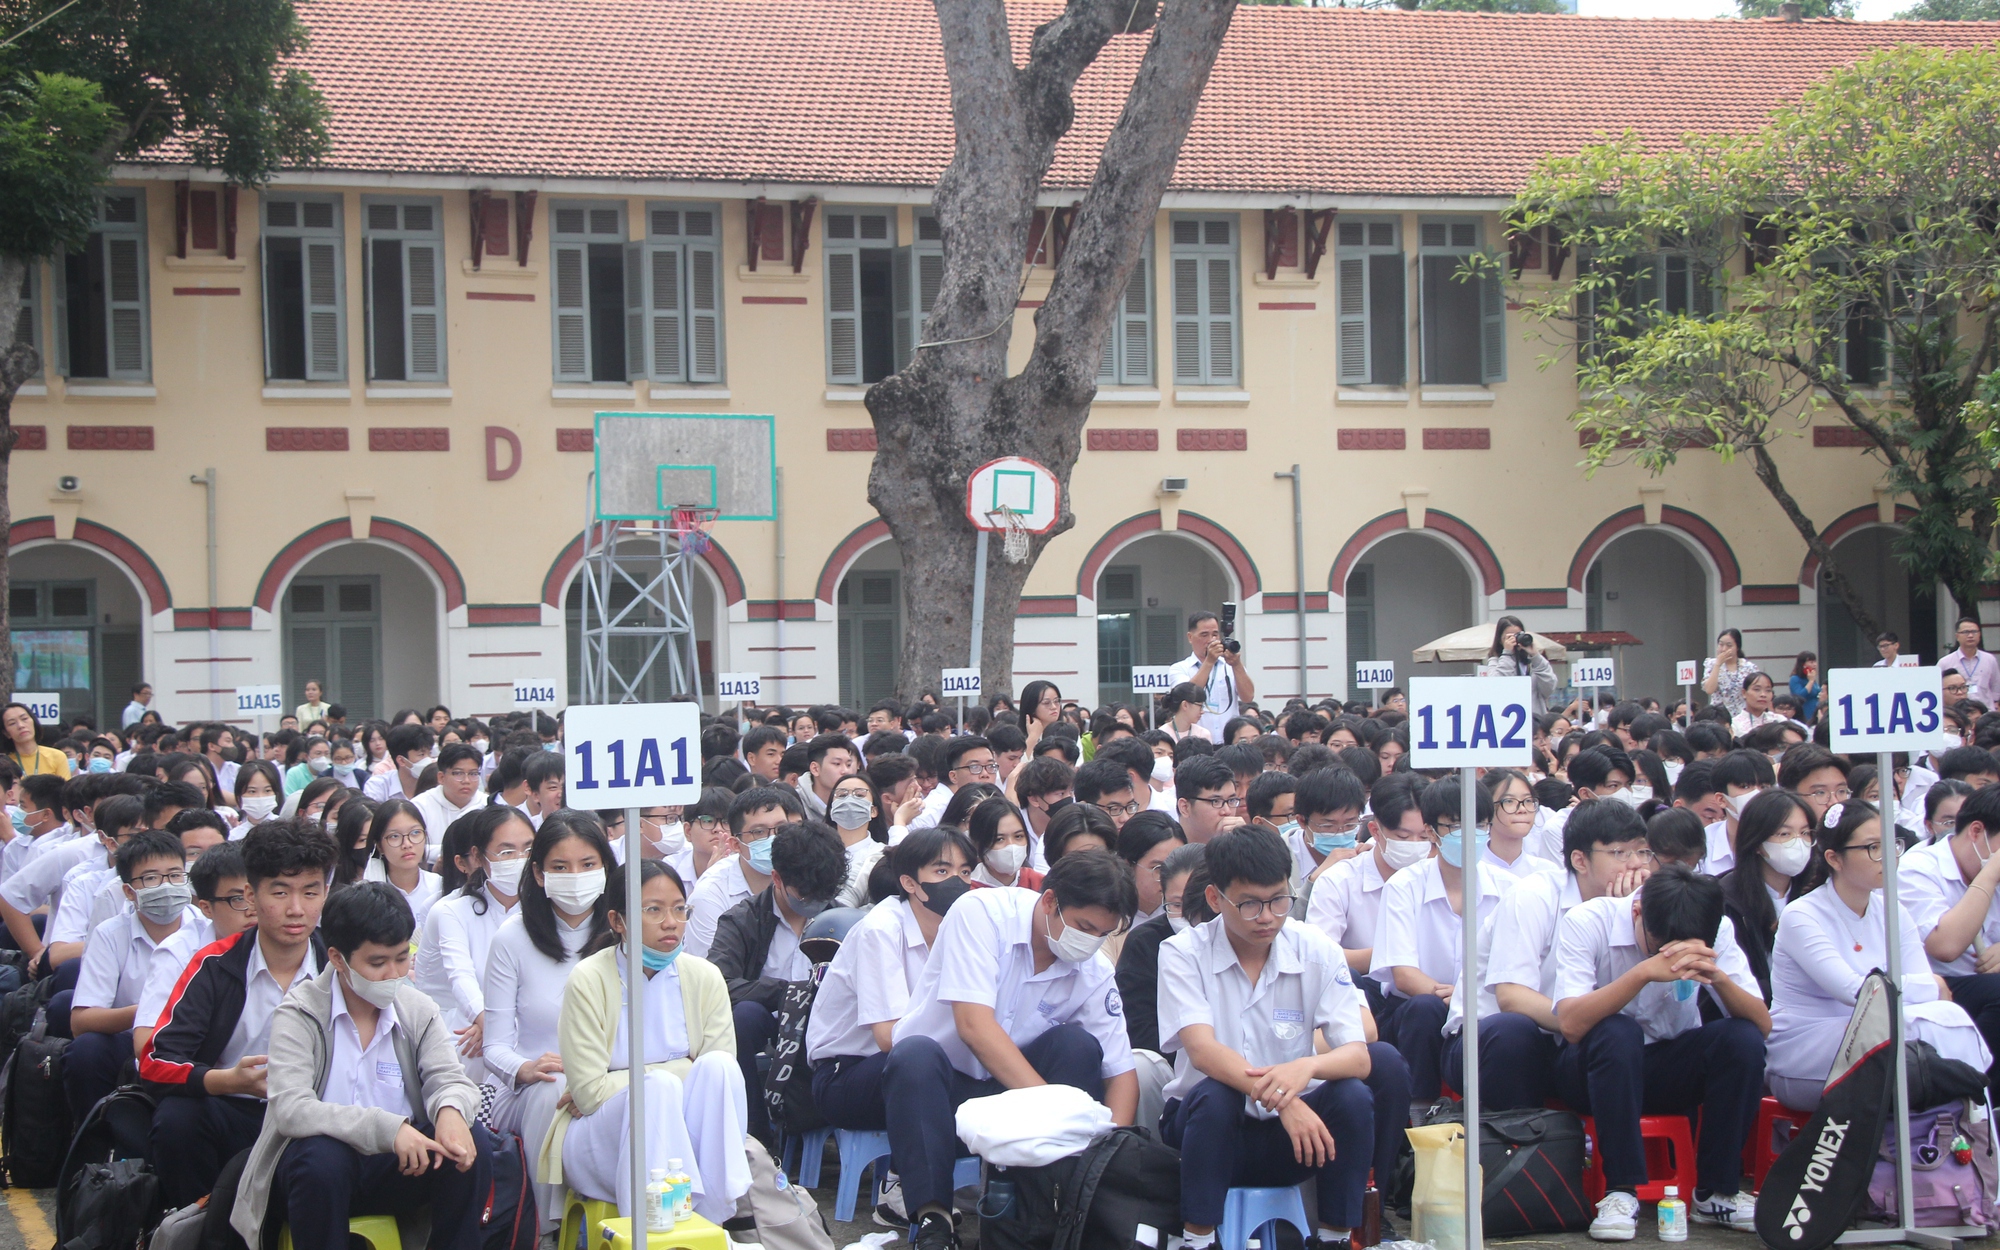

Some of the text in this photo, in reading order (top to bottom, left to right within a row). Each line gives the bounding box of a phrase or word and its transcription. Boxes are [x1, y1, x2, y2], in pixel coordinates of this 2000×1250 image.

[485, 426, 522, 481] D
[1133, 674, 1170, 688] 11A11
[1357, 669, 1393, 683] 11A10
[1580, 667, 1612, 682] 11A9
[719, 680, 760, 696] 11A13
[943, 676, 980, 692] 11A12
[238, 694, 281, 710] 11A15
[514, 687, 555, 702] 11A14
[1838, 690, 1940, 736] 11A3
[1417, 703, 1527, 750] 11A2
[575, 736, 694, 790] 11A1
[1800, 1116, 1850, 1193] YONEX
